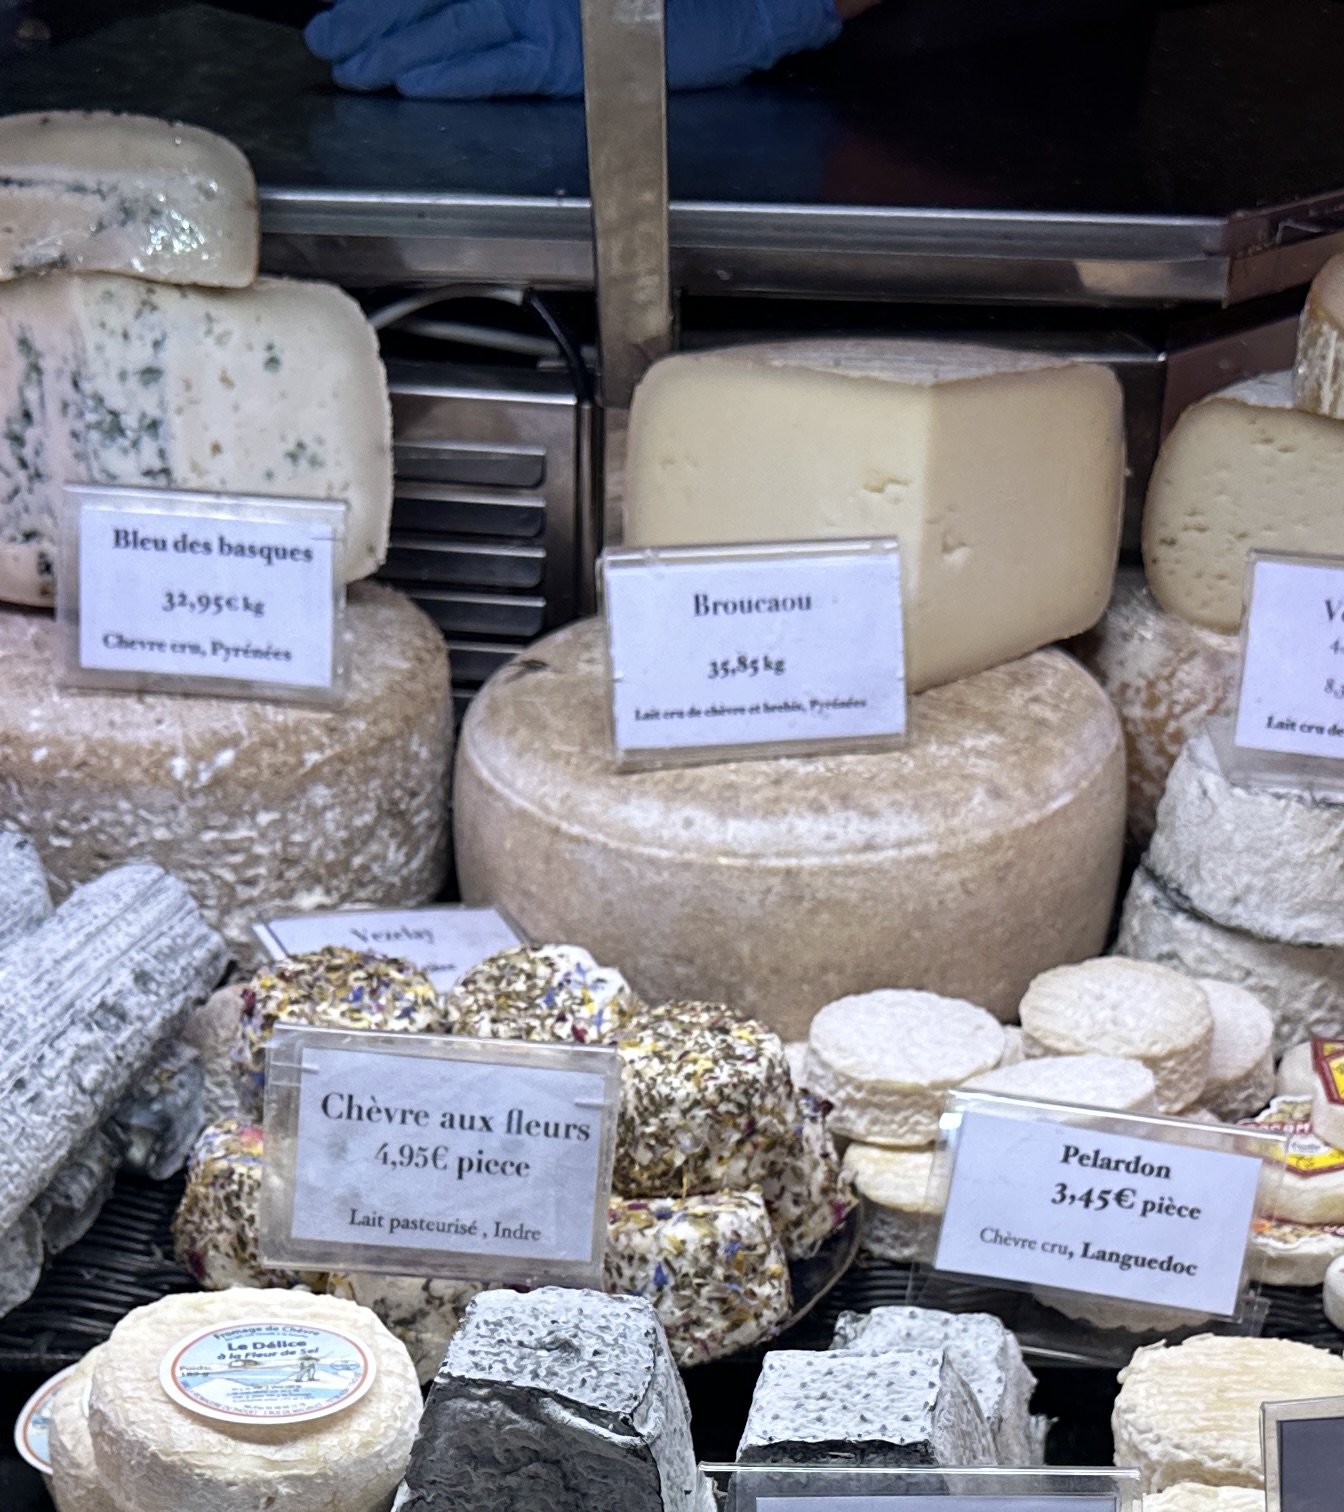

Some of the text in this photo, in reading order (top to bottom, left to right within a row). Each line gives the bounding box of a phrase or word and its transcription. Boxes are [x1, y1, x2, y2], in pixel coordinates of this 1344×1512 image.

[112, 528, 314, 566] Bleu des basques
[693, 592, 812, 617] Broucaou
[708, 654, 786, 679] 35,85 kg
[1266, 715, 1296, 733] Lait
[1300, 721, 1325, 737] cru
[1328, 722, 1344, 738] de
[321, 1090, 592, 1142] Chèvre aux fleurs
[373, 1142, 449, 1172] 4,95€
[1060, 1143, 1173, 1180] Pelardon
[1050, 1181, 1202, 1221] 3,45€ pièce
[349, 1208, 542, 1243] Lait pasteurisé Indre
[979, 1226, 1198, 1278] Chèvre cru, Languedoc
[227, 1339, 308, 1351] Le Délice
[244, 1350, 278, 1360] Fleur
[299, 1347, 319, 1355] Sel
